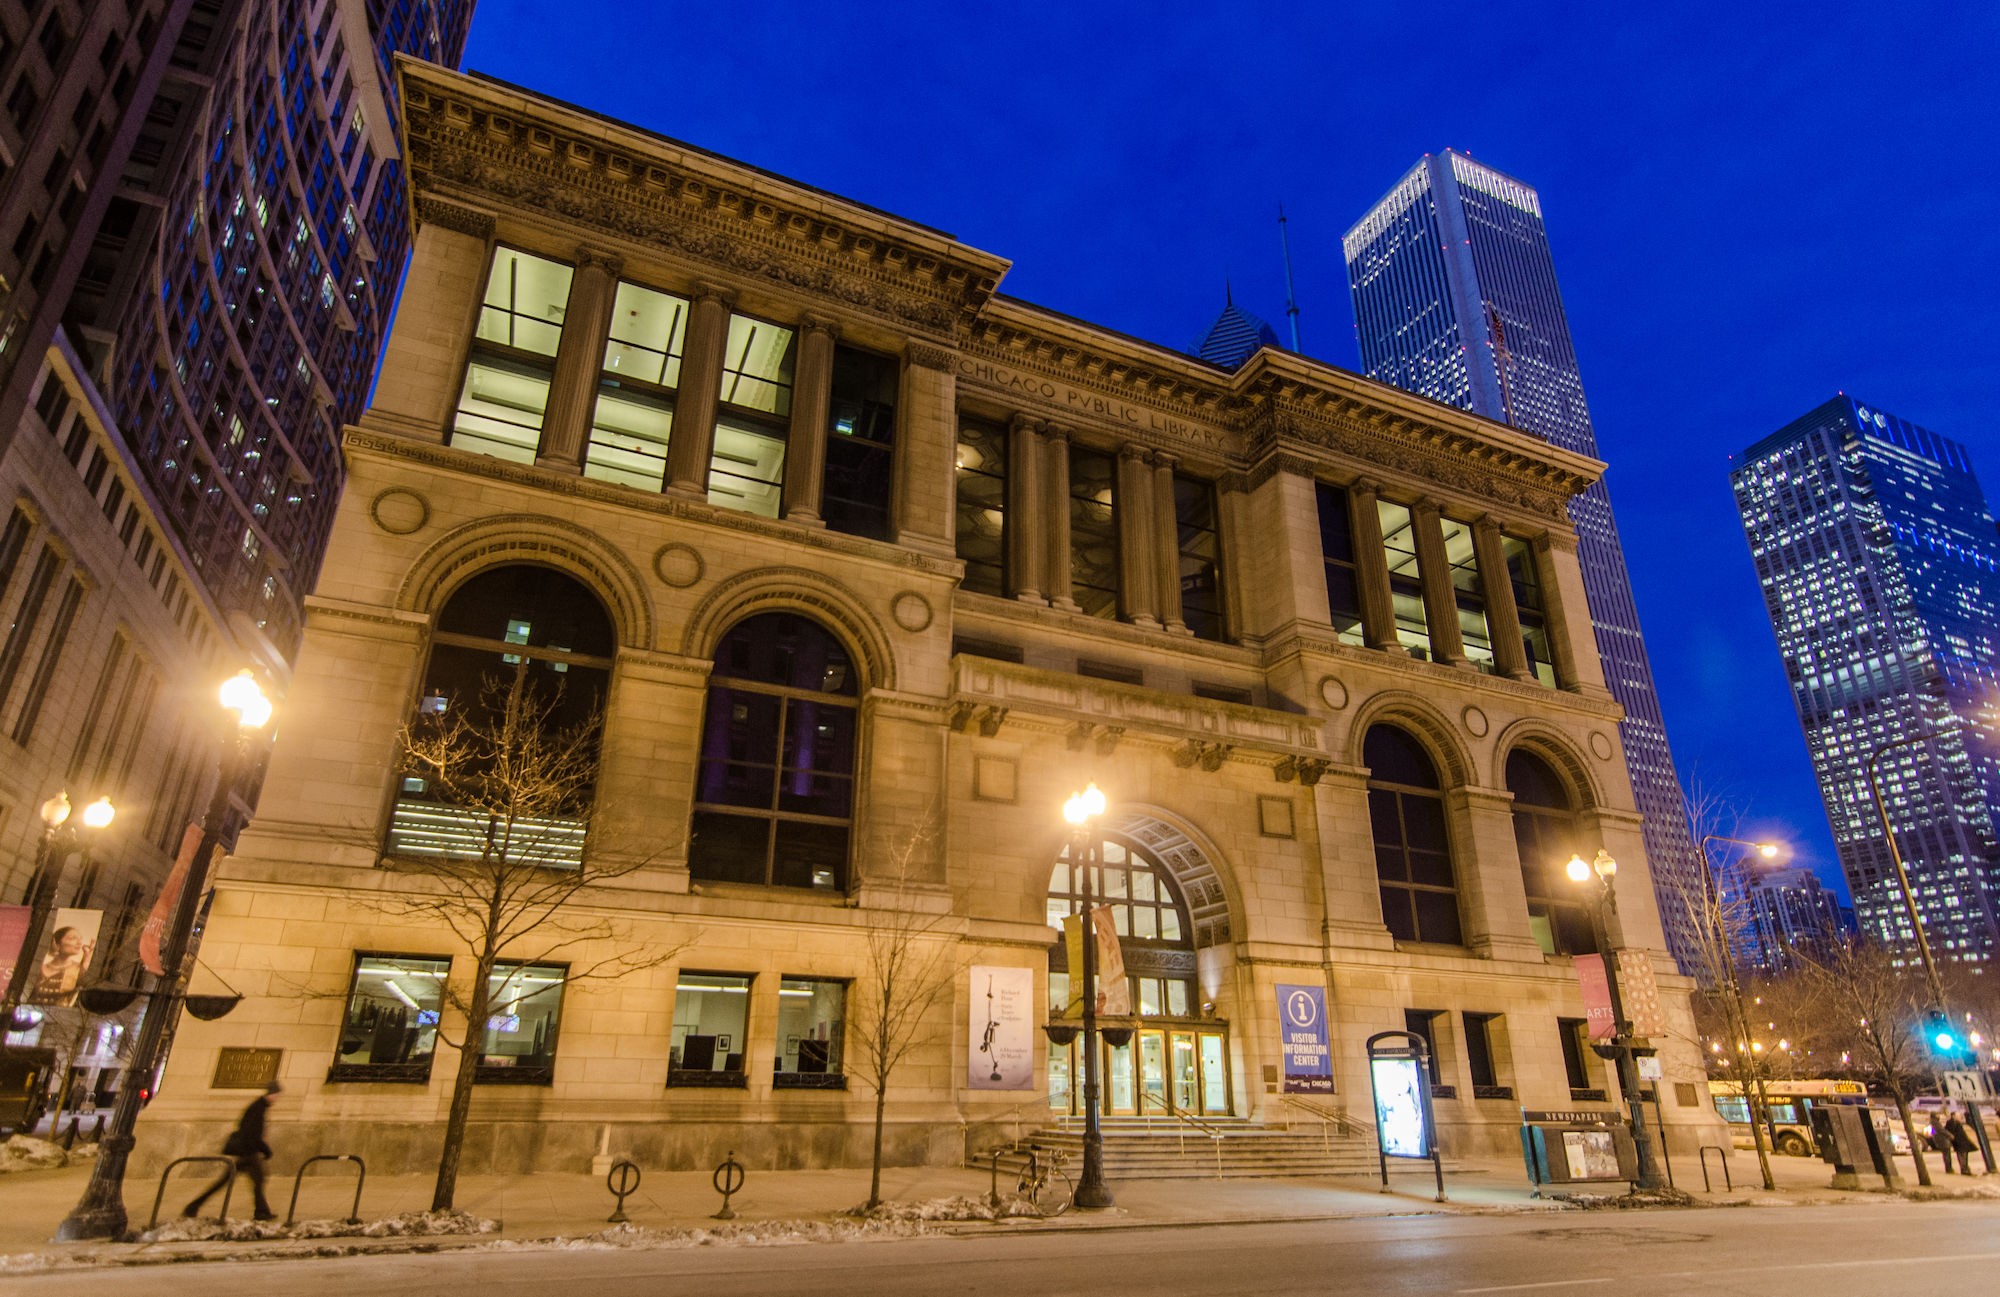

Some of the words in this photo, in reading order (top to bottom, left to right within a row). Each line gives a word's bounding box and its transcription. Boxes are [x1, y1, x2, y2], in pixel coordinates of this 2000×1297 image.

[959, 360, 1056, 399] CHICAGO
[1067, 392, 1139, 423] PVBLIC
[1151, 413, 1225, 448] LIBRARY
[1587, 1007, 1614, 1019] ARTS
[1291, 1032, 1318, 1044] VISITOR
[1283, 1043, 1328, 1056] INFORMATION
[1293, 1055, 1320, 1067] CENTER
[1545, 1112, 1602, 1121] NEWSPAPERS
